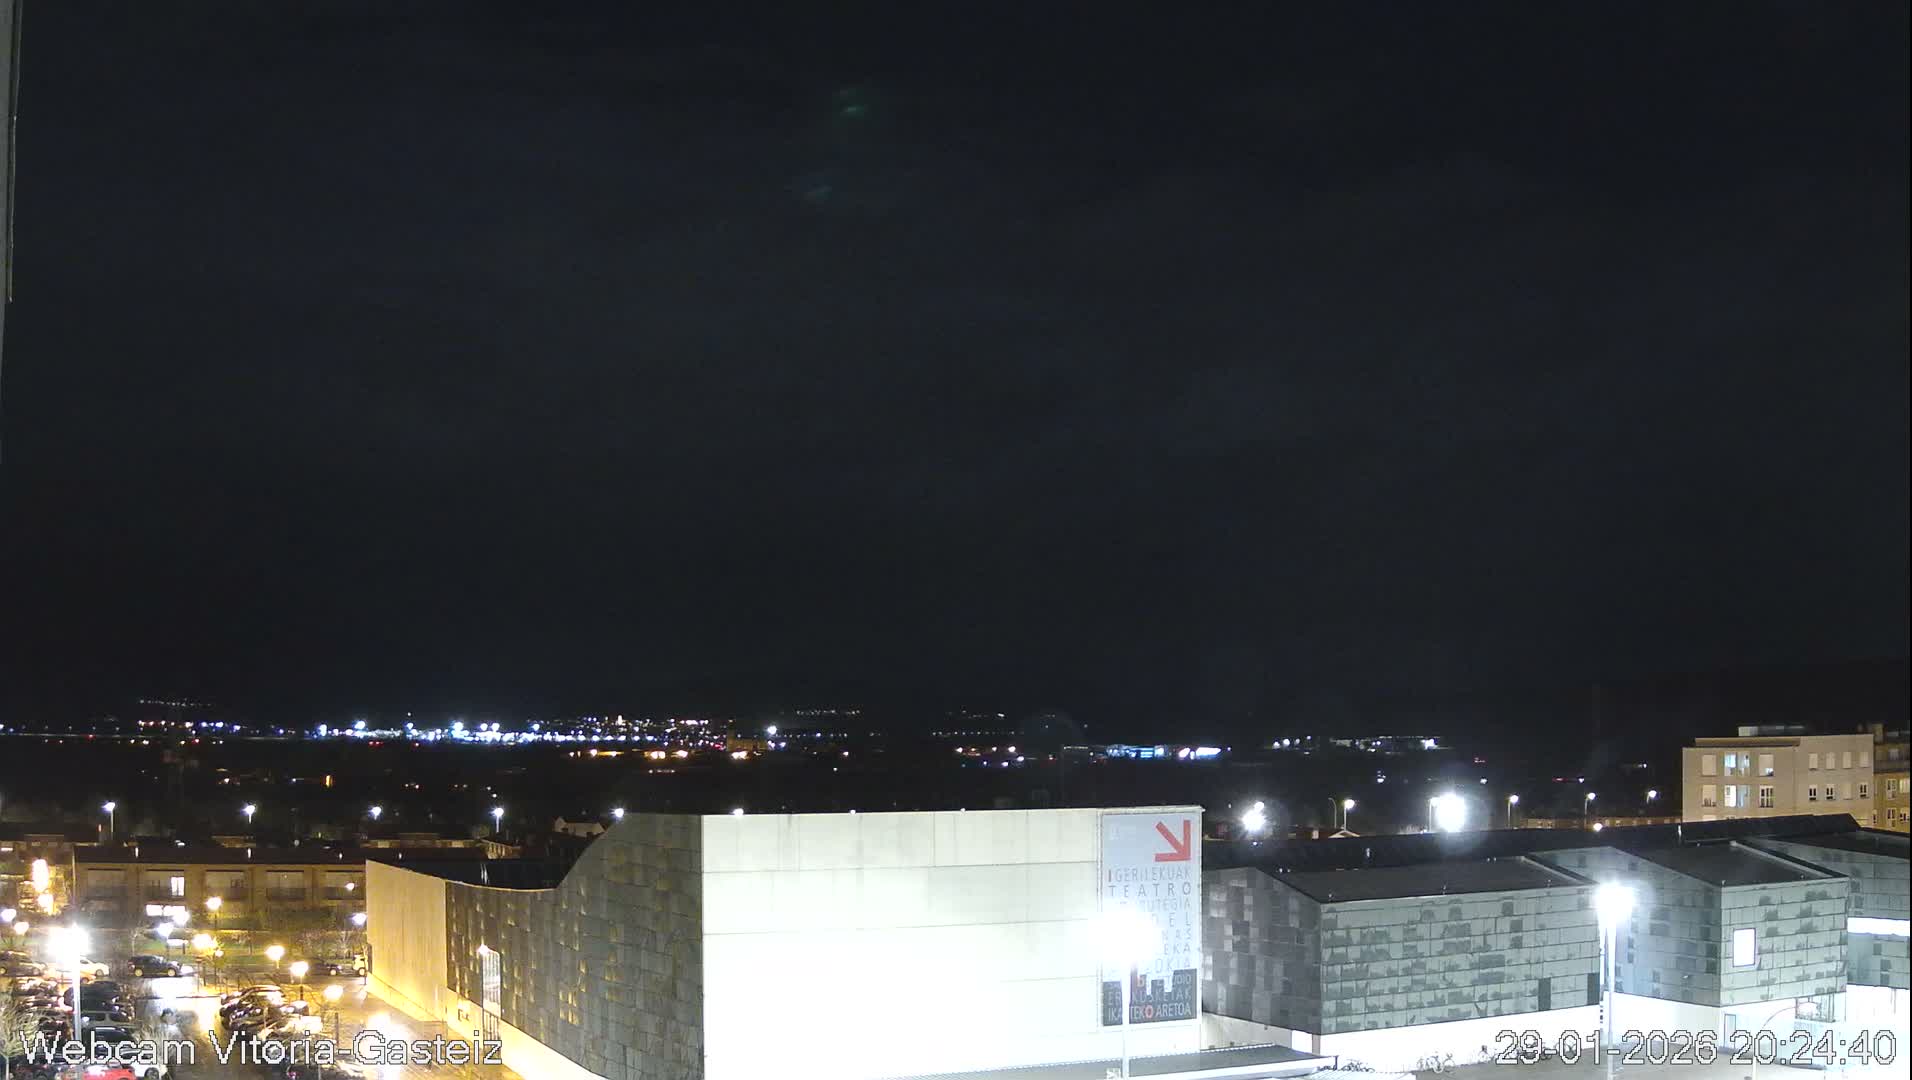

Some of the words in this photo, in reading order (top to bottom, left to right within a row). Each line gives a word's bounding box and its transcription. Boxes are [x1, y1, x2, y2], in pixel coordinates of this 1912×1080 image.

[1107, 866, 1191, 882] IGERILEKUAK
[1107, 881, 1191, 898] TEATRO
[1108, 1004, 1153, 1021] IKATEKO
[1155, 1002, 1191, 1017] ARETOA
